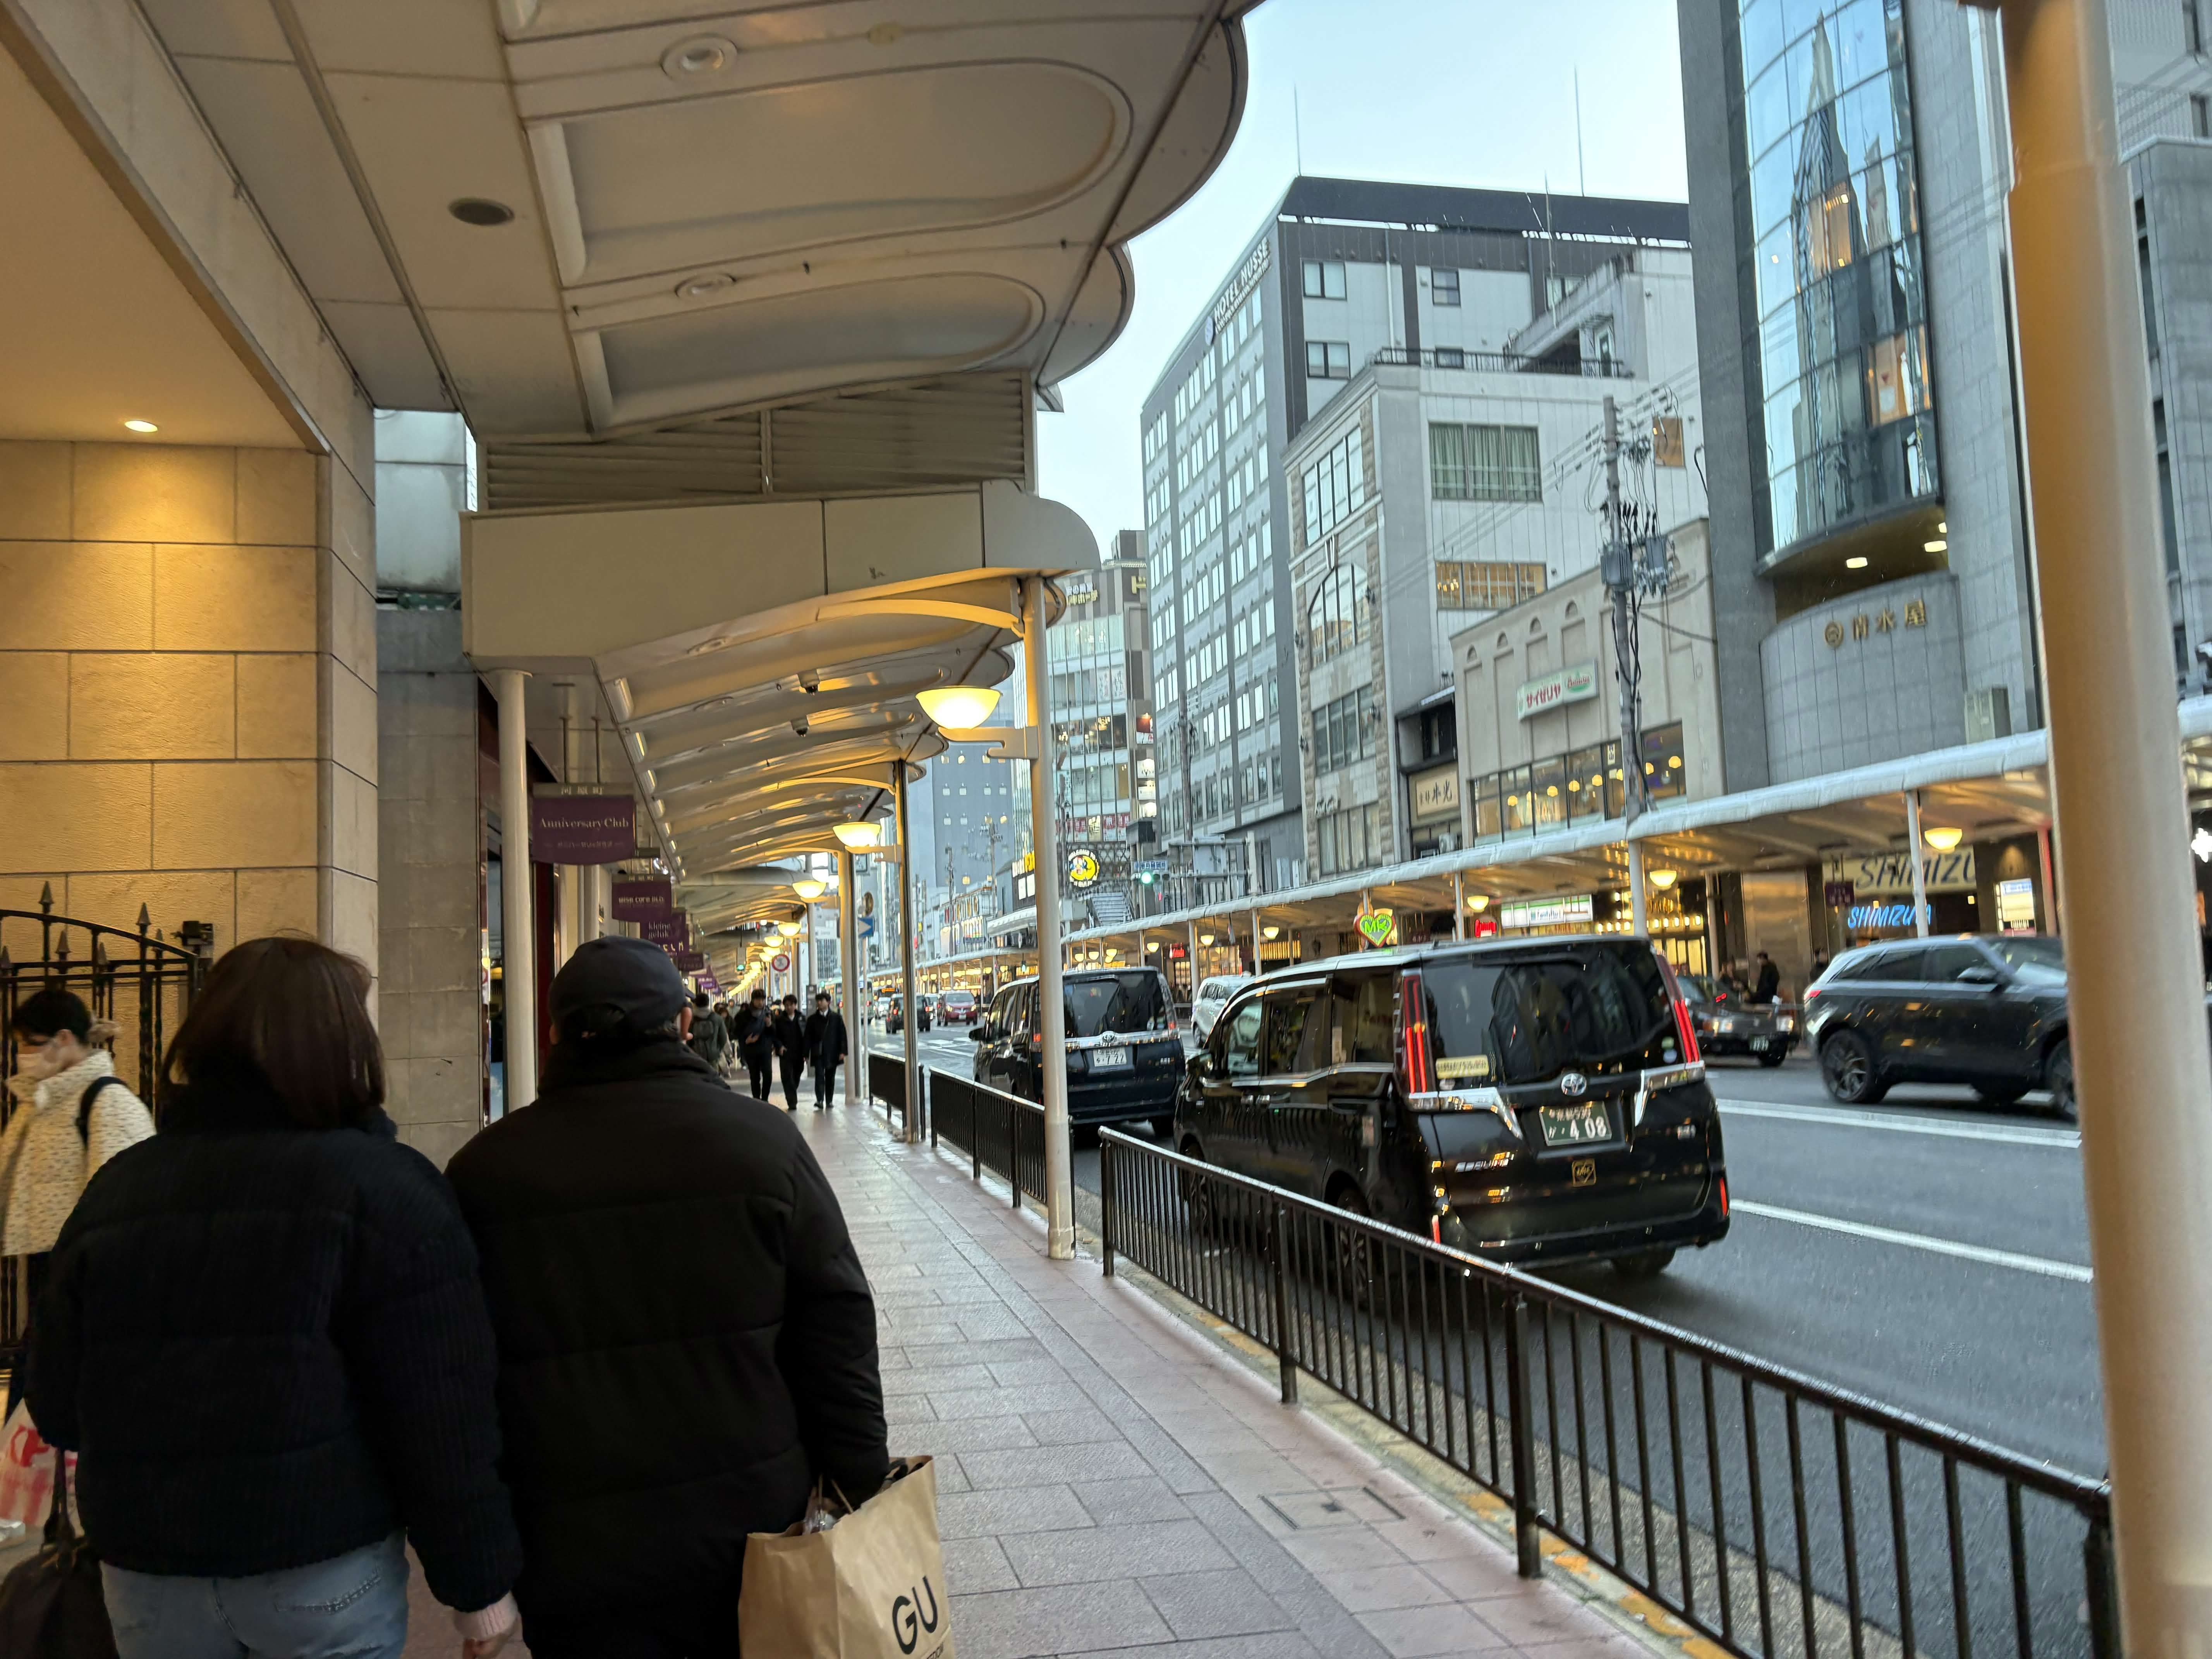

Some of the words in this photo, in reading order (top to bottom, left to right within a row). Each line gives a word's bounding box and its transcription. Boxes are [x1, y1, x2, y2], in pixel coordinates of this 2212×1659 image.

[1214, 278, 1240, 325] HOTEL
[1526, 683, 1561, 708] サイゼリヤ
[541, 817, 602, 830] Anniversary
[604, 817, 629, 828] Club
[1364, 920, 1386, 934] MK
[892, 1575, 938, 1655] GU
